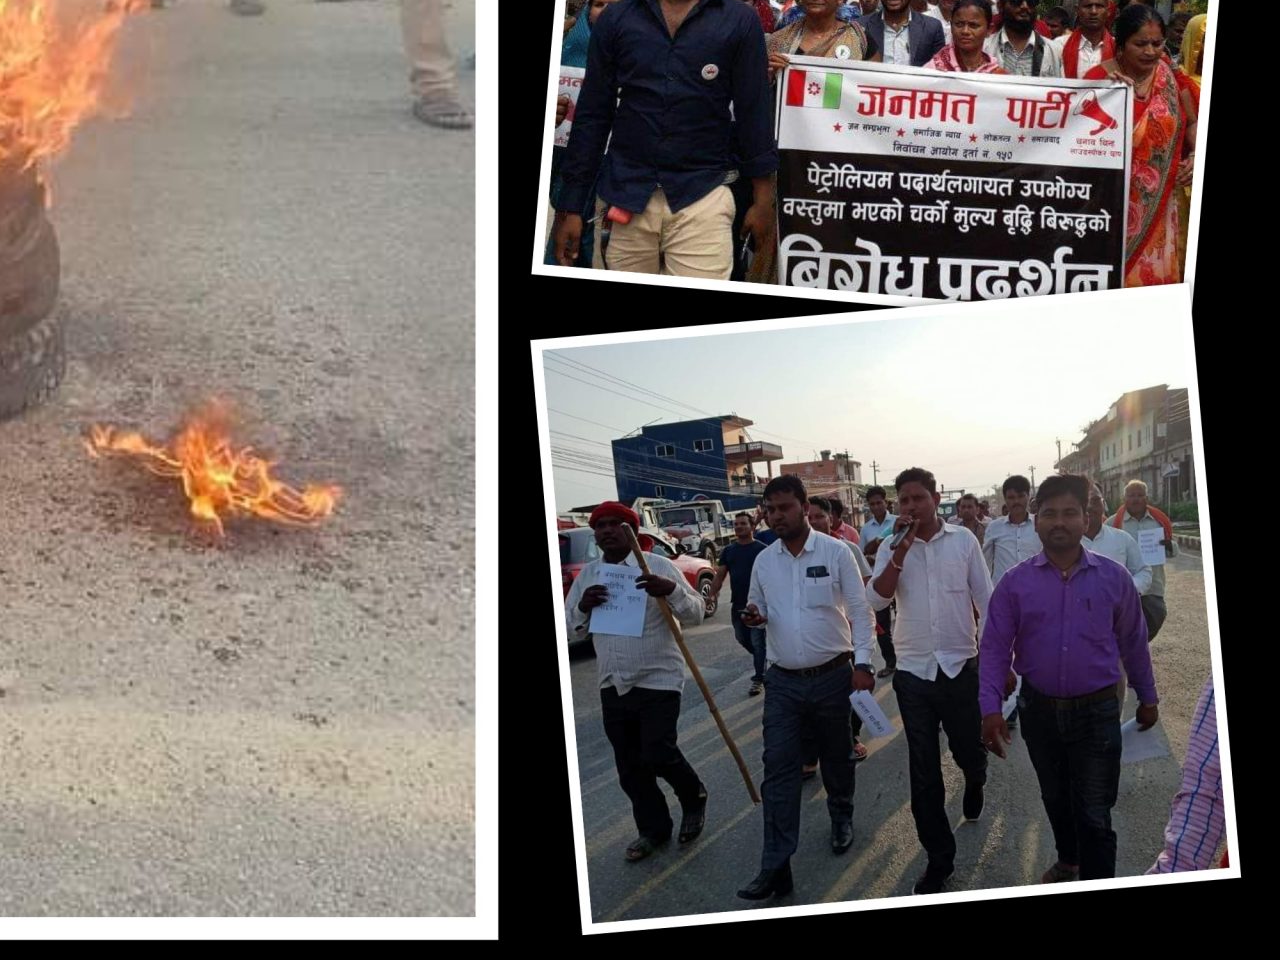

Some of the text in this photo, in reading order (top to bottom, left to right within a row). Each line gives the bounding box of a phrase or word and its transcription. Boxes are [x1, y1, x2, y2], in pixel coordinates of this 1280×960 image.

[856, 84, 1078, 129] जनमत पार्टी
[847, 122, 859, 132] जन
[912, 126, 942, 138] समाजिक
[945, 130, 962, 139] न्याय
[892, 140, 926, 154] निर्वाचन
[929, 145, 959, 157] आयोग
[962, 144, 979, 158] दर्ता
[996, 151, 1013, 161] १५०
[807, 161, 1092, 201] पेट्रोलियम पदार्थलगायत उपभोग्य
[783, 198, 846, 226] वस्तुमा
[852, 197, 904, 223] भएको
[910, 199, 951, 224] चर्को
[953, 206, 997, 233] मुल्य
